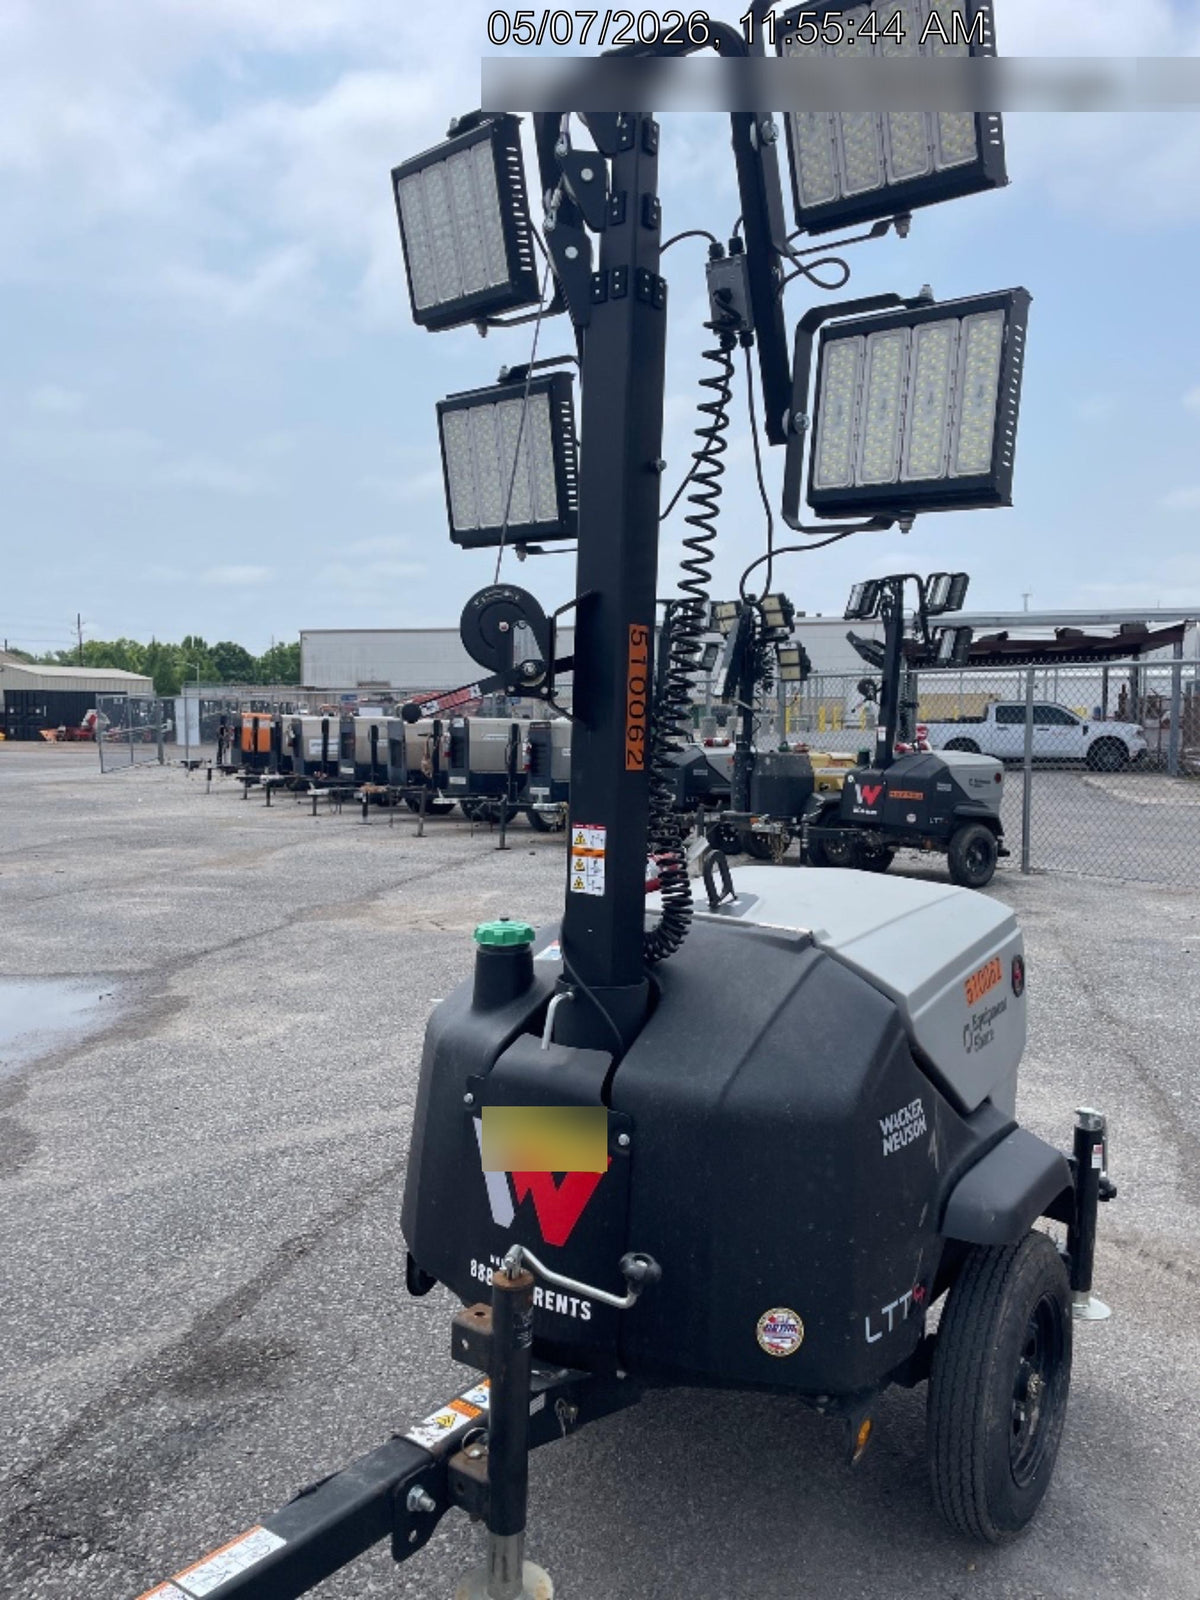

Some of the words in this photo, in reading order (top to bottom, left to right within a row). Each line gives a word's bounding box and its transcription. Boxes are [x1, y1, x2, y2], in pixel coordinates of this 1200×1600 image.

[627, 629, 648, 766] 510062
[879, 1098, 924, 1136] WACKER
[882, 1114, 927, 1156] NEUSON
[532, 1286, 592, 1320] RENTS
